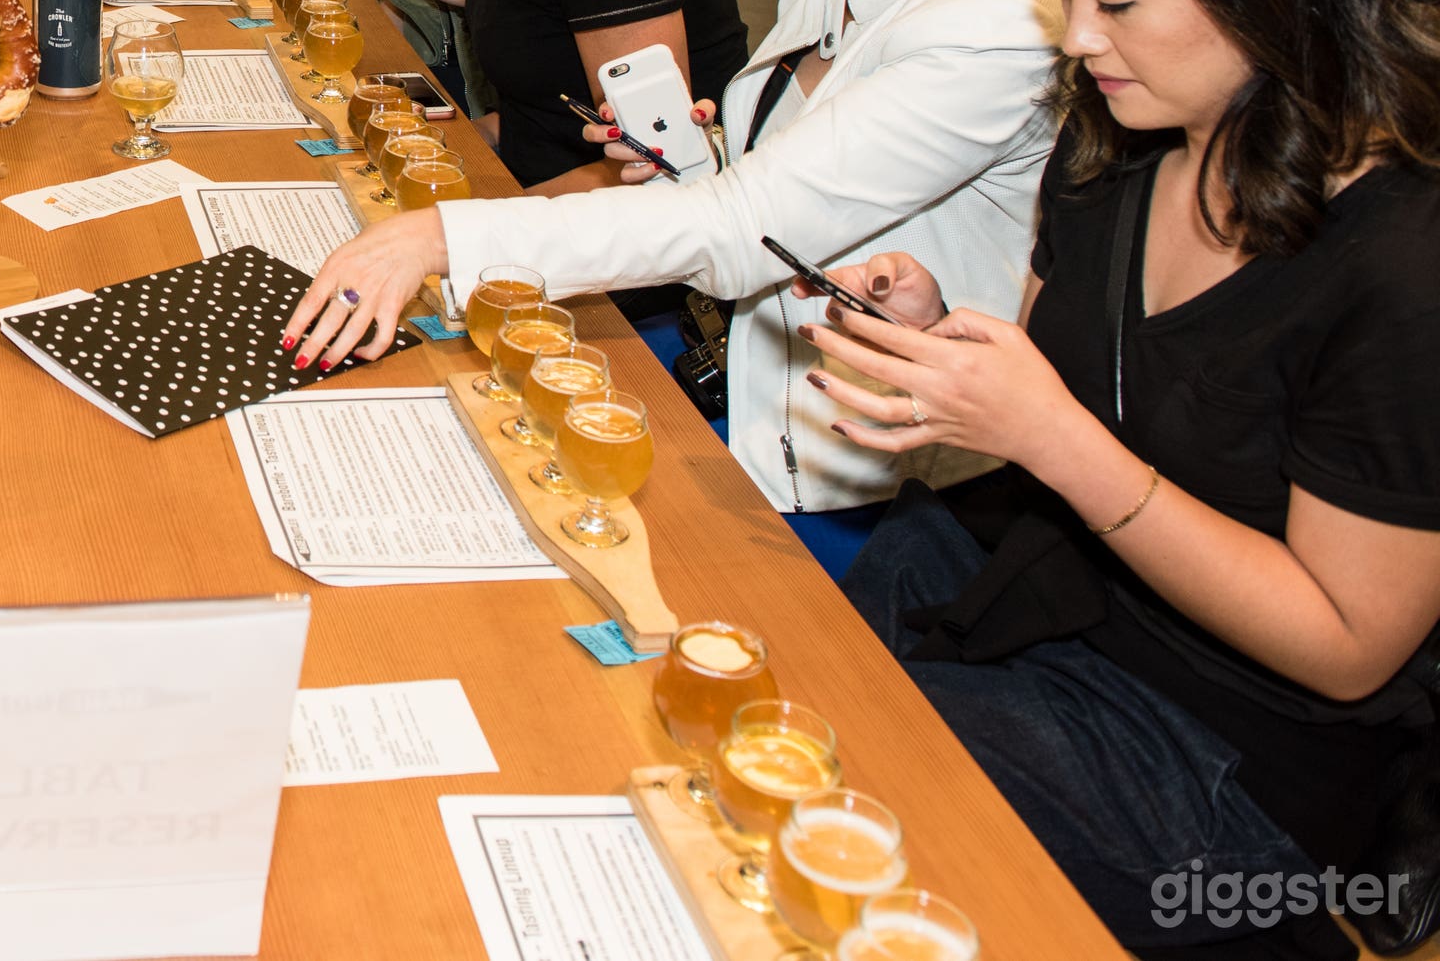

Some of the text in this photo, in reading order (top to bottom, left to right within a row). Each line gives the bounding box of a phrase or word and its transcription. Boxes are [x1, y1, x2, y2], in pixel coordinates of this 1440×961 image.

[254, 413, 271, 437] Lineup
[262, 438, 279, 464] Tasting
[272, 472, 297, 511] Barebottle
